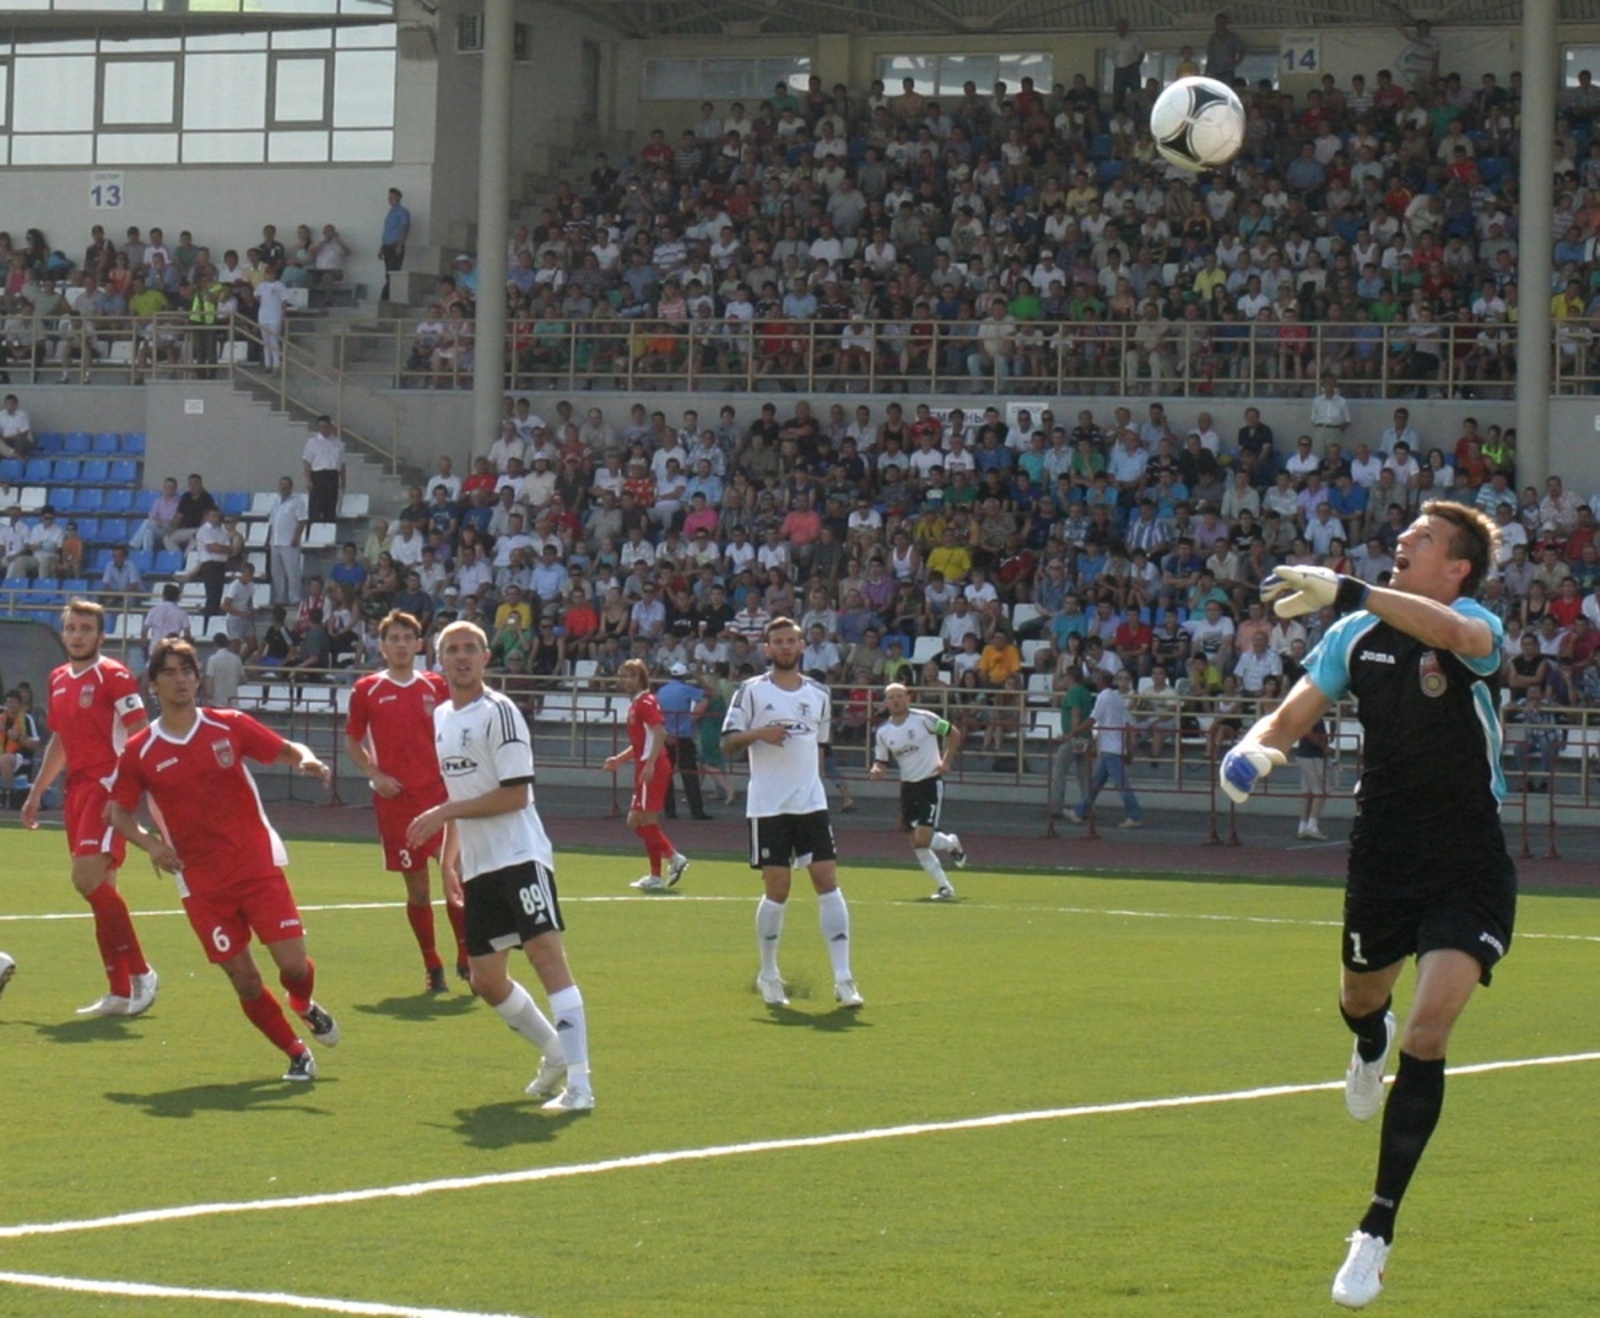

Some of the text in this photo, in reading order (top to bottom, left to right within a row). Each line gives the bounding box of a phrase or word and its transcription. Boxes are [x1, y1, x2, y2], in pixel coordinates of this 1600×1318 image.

[1283, 48, 1317, 70] 14
[91, 185, 120, 207] 13
[125, 696, 135, 709] C
[399, 849, 412, 868] 3
[519, 884, 545, 915] 89
[212, 926, 231, 952] 6
[1350, 932, 1368, 965] 1
